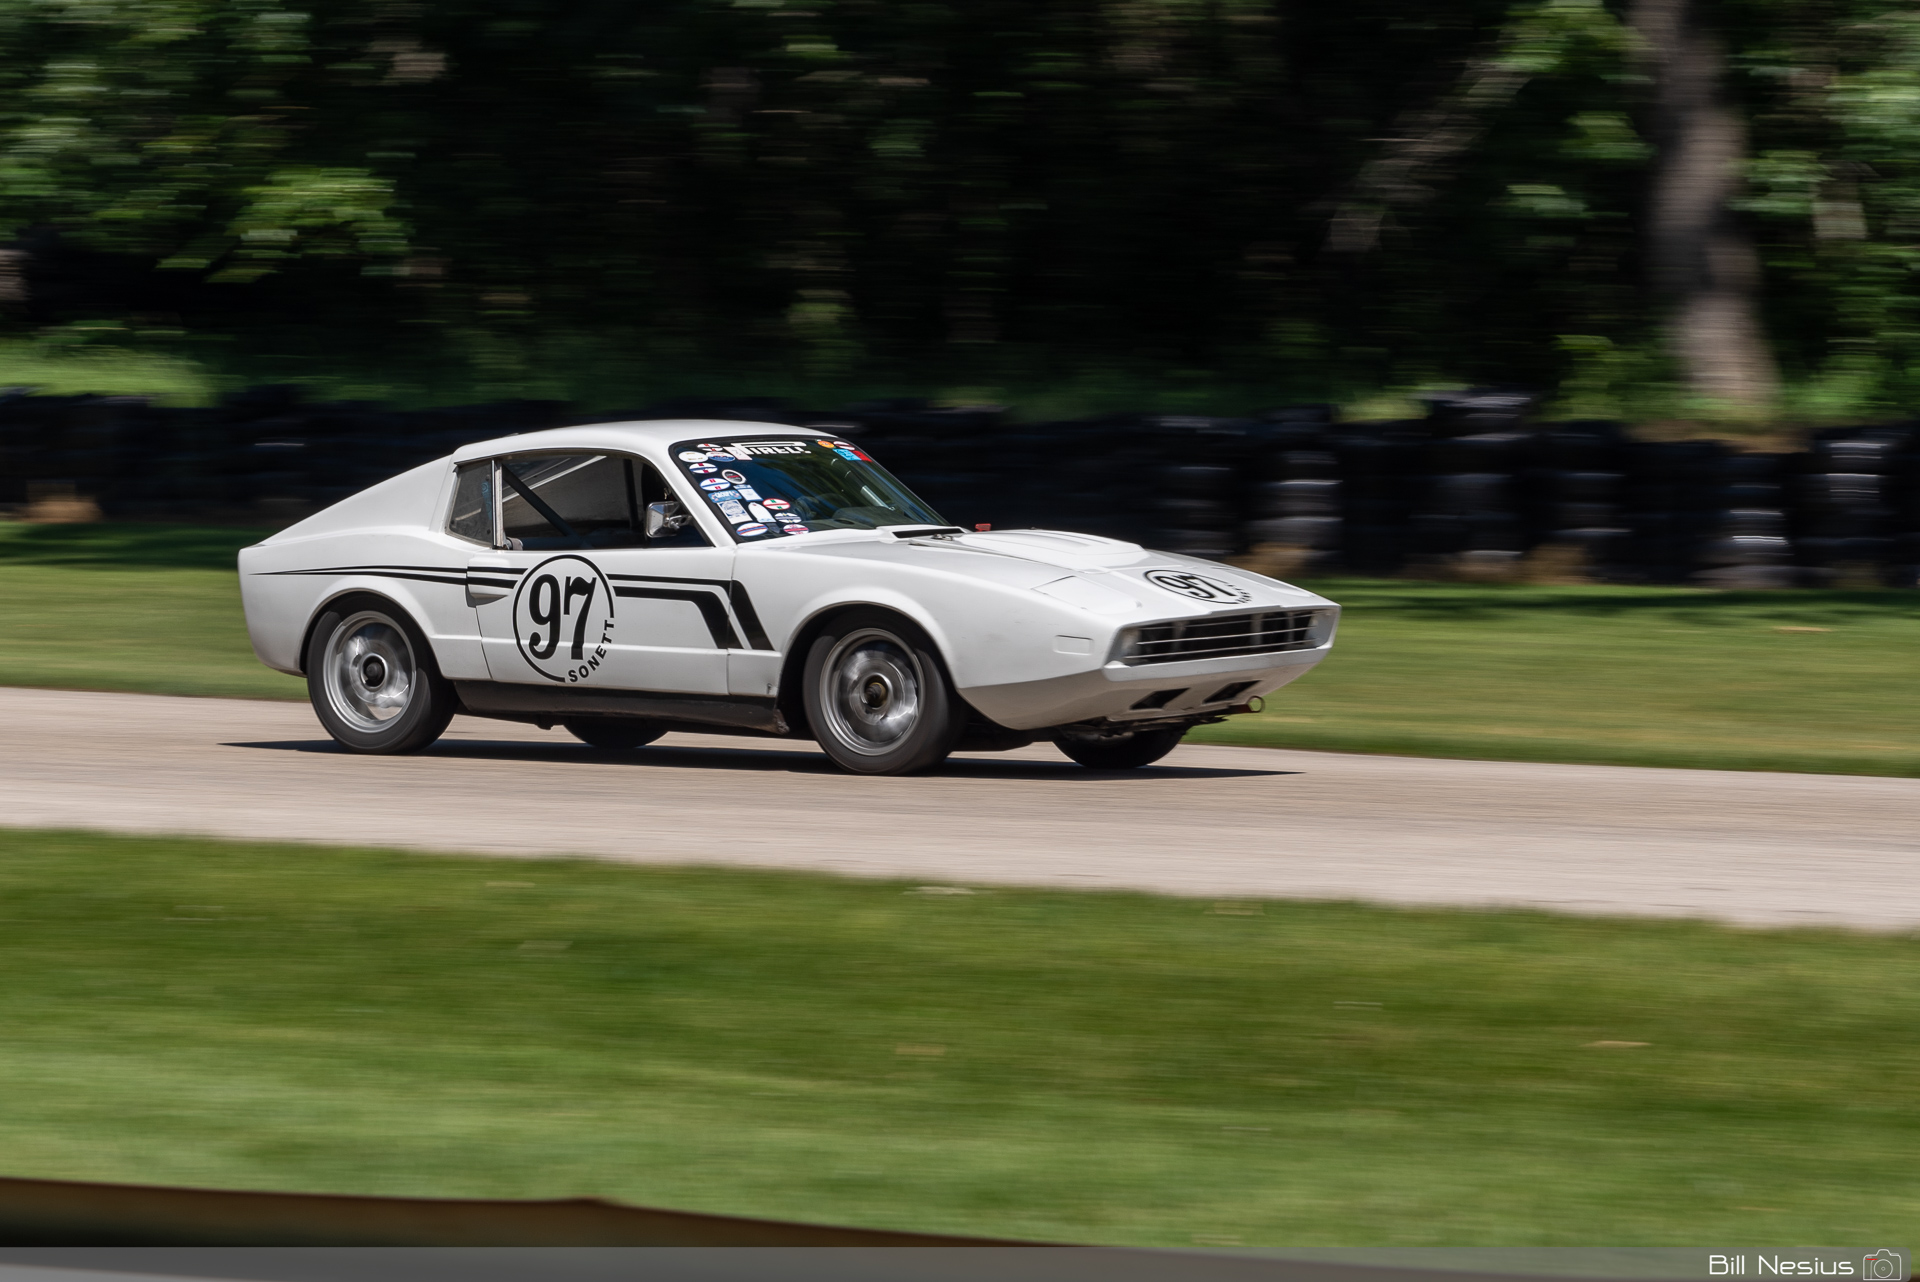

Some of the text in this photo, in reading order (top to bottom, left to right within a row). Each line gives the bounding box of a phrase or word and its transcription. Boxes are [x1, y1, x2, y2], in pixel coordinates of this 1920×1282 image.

[528, 573, 597, 660] 97
[1154, 574, 1236, 599] 97
[567, 619, 615, 683] SONETT
